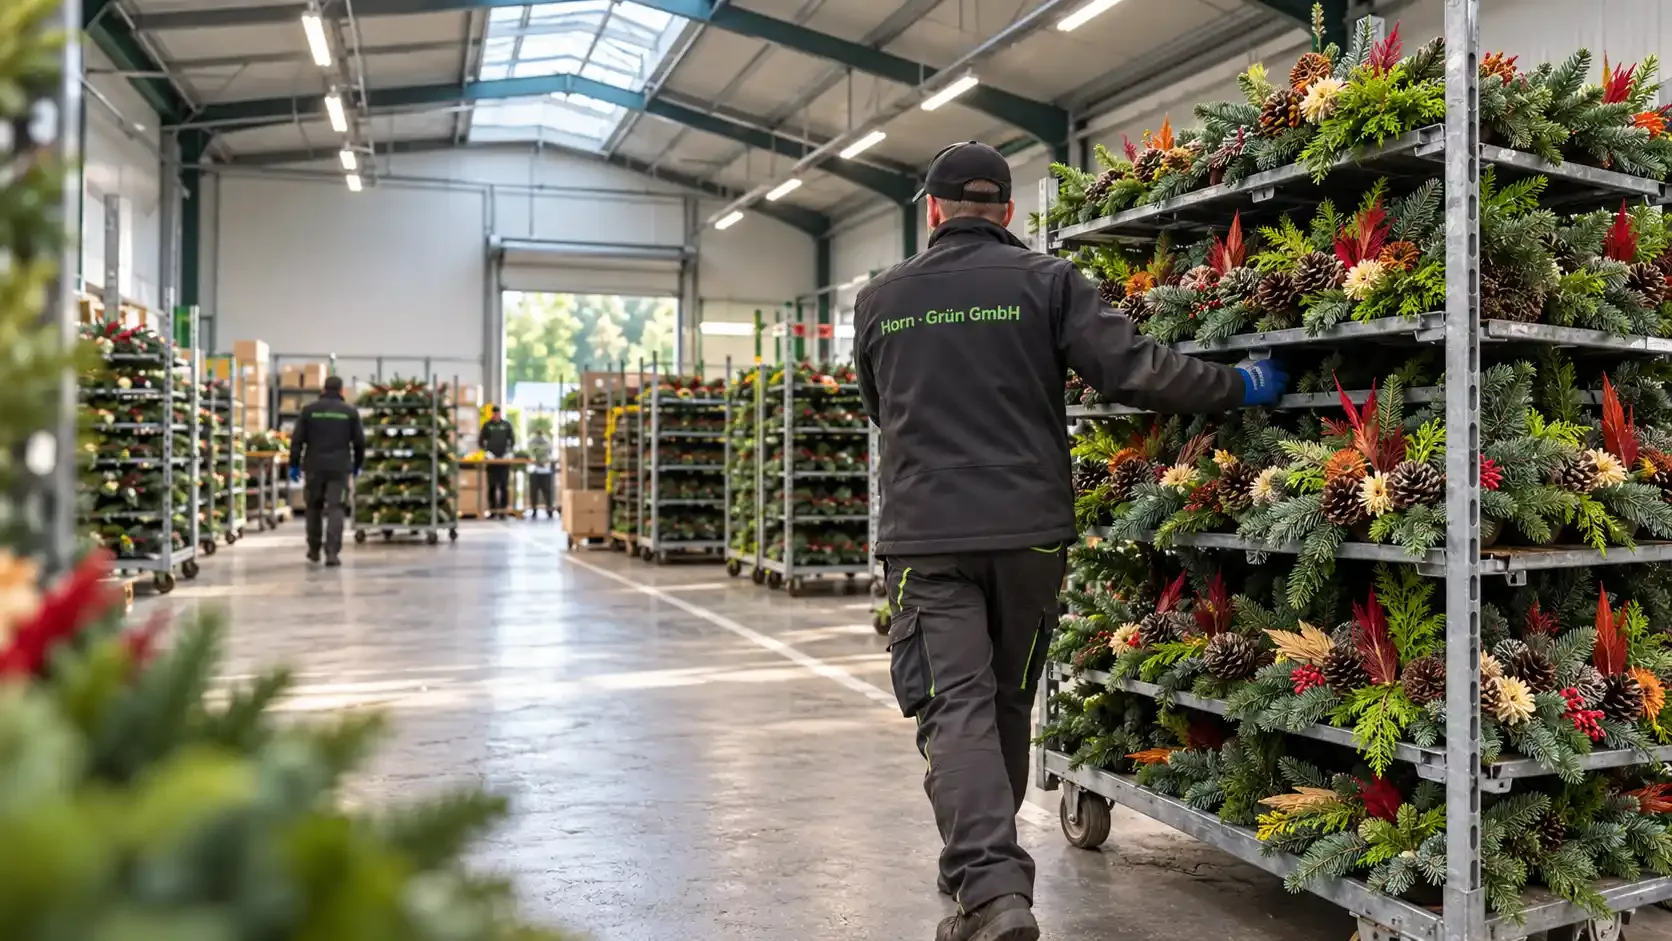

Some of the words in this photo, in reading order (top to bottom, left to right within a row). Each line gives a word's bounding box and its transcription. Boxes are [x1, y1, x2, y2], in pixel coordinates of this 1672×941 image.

[881, 316, 915, 336] Horn
[925, 308, 965, 324] Grün
[969, 305, 1020, 321] GmbH
